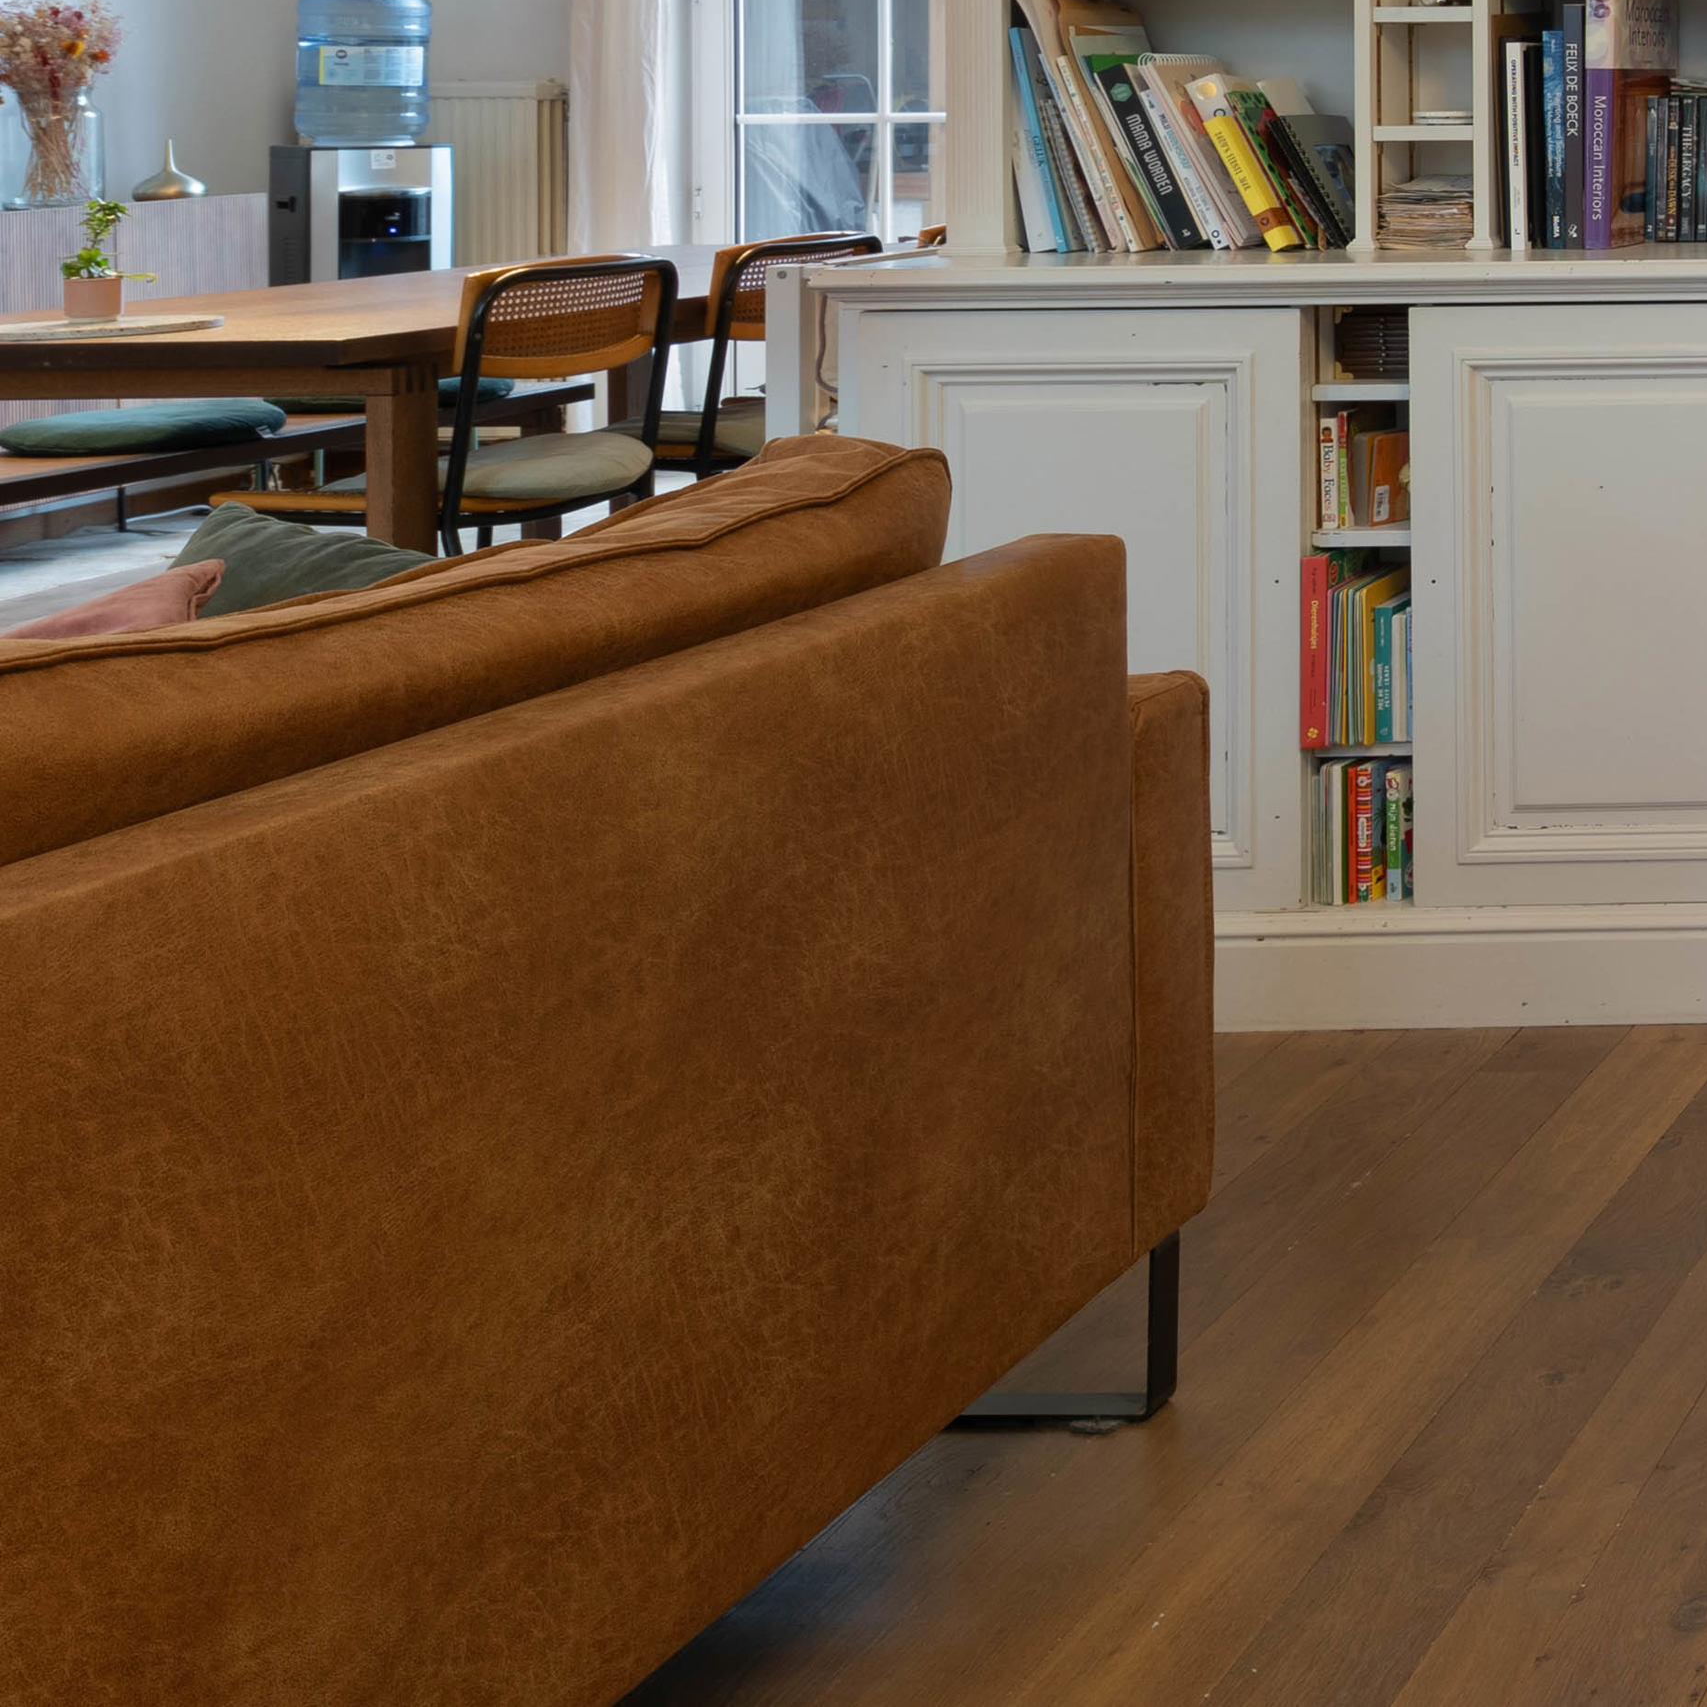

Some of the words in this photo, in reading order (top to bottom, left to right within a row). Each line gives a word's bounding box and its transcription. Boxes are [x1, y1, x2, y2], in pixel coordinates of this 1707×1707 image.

[1566, 43, 1578, 71] FELIX
[1567, 76, 1578, 90] DE
[1567, 95, 1578, 136] BOECK
[1592, 95, 1606, 160] Moroccan
[1682, 124, 1692, 150] THE
[1126, 114, 1152, 151] MAMA
[1144, 154, 1172, 196] WORDEN
[1682, 154, 1692, 198] LEGACY
[1591, 165, 1606, 220] Interiors
[1668, 190, 1677, 214] DAWN
[1322, 445, 1335, 473] Baby
[1324, 478, 1335, 511] Faces
[1387, 802, 1398, 822] mijn
[1389, 824, 1398, 851] dieren
